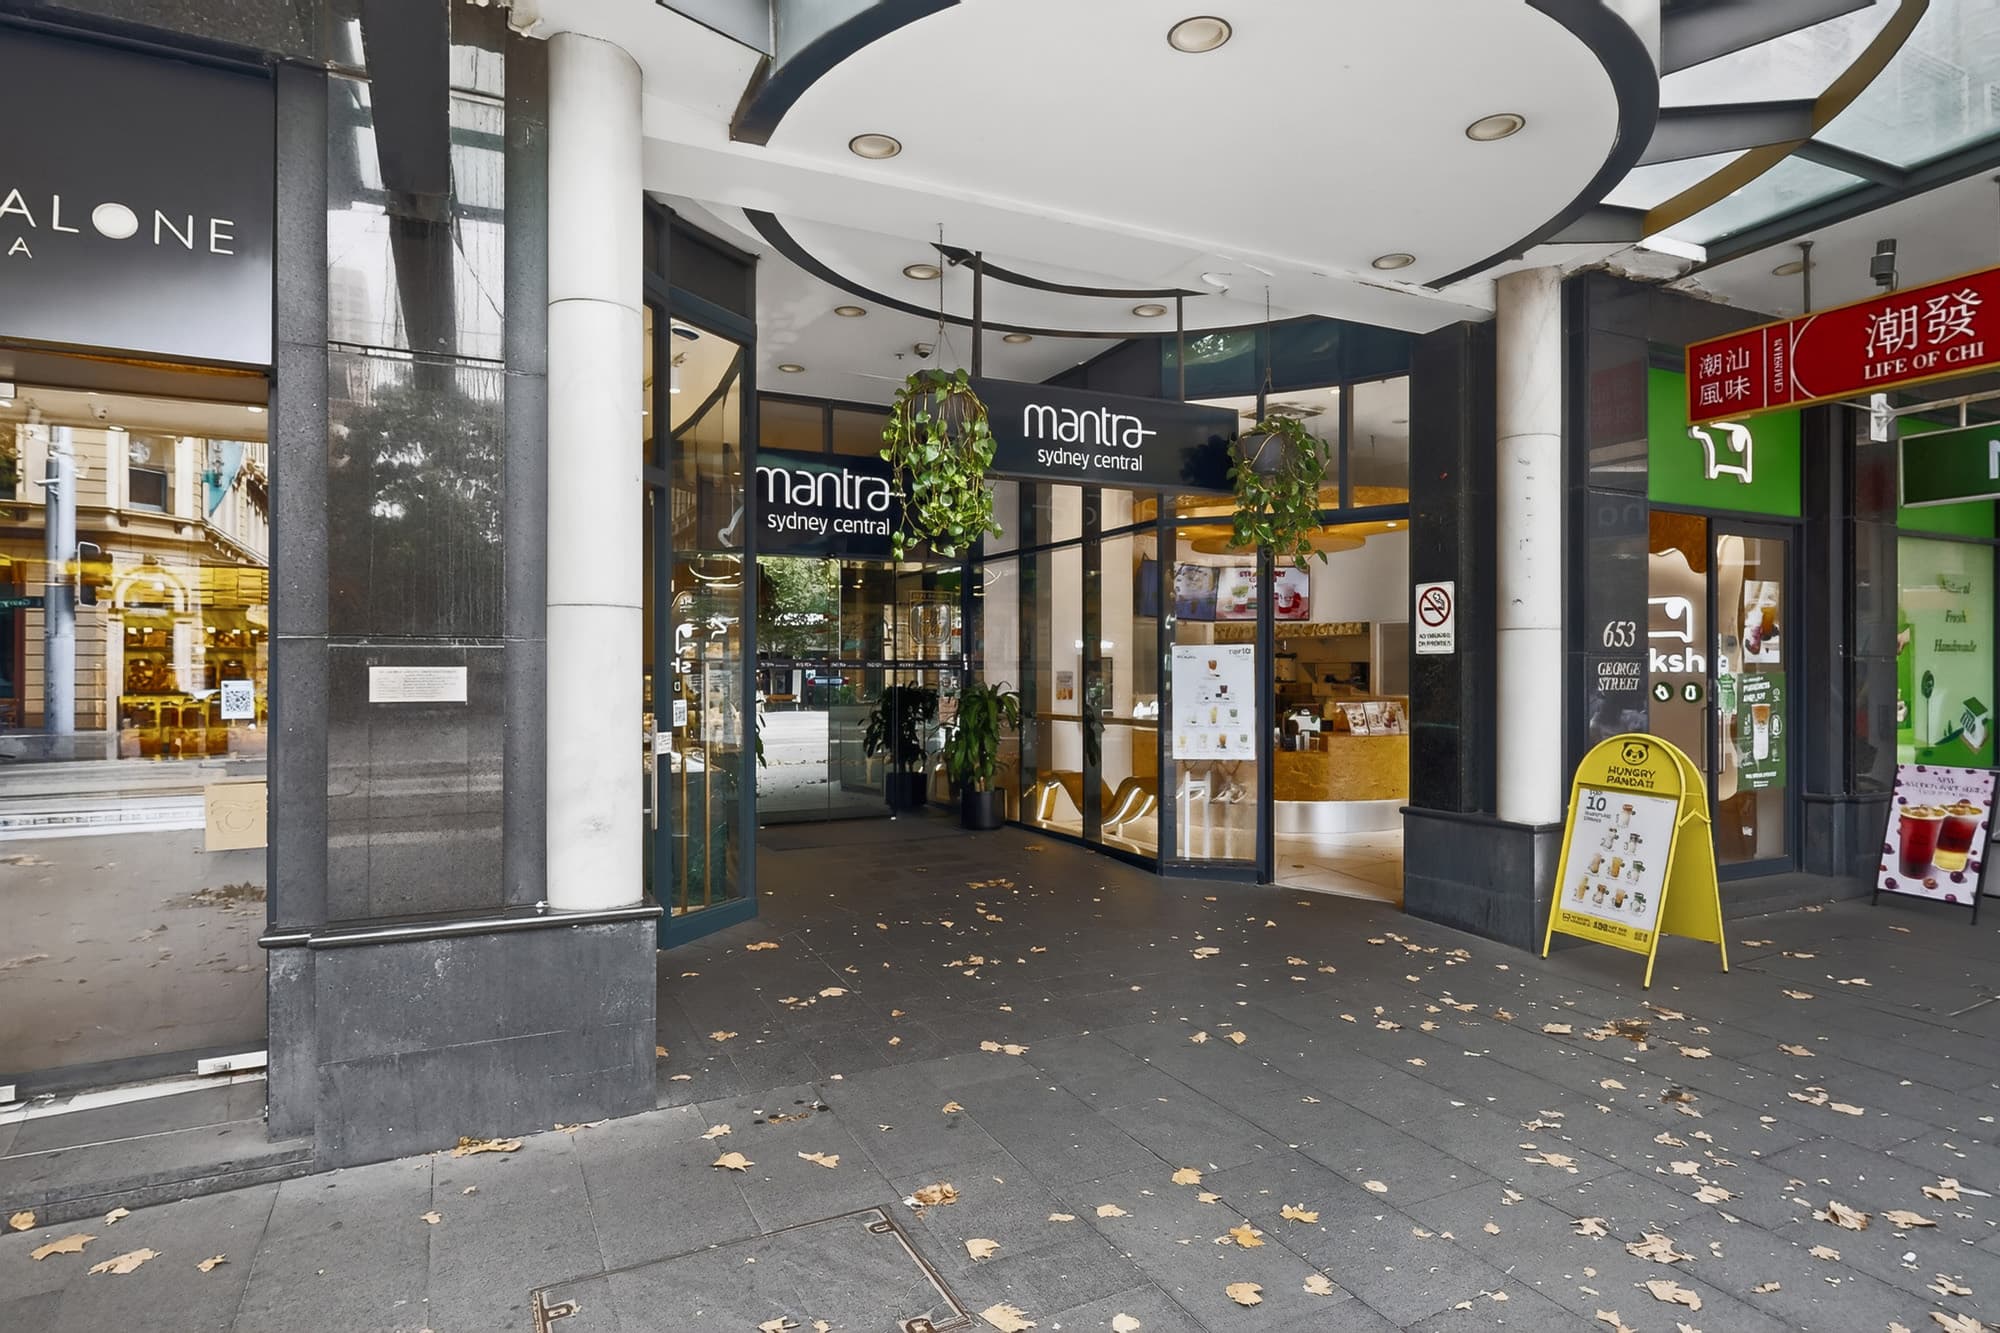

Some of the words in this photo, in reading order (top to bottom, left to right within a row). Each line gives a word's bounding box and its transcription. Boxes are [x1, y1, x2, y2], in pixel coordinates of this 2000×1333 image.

[1864, 358, 1908, 380] LIFE
[1912, 350, 1941, 370] OF
[1945, 341, 1984, 363] CHI
[1023, 403, 1157, 449] mantra
[1037, 447, 1090, 471] sydney
[1094, 454, 1143, 472] central
[755, 465, 899, 512] mantra
[767, 511, 828, 536] sydney
[833, 518, 890, 536] central
[1603, 620, 1637, 649] 653
[1597, 661, 1641, 677] GEORGE
[1598, 677, 1640, 692] STREET
[1608, 765, 1656, 780] HUNGRY
[1586, 796, 1607, 812] 10
